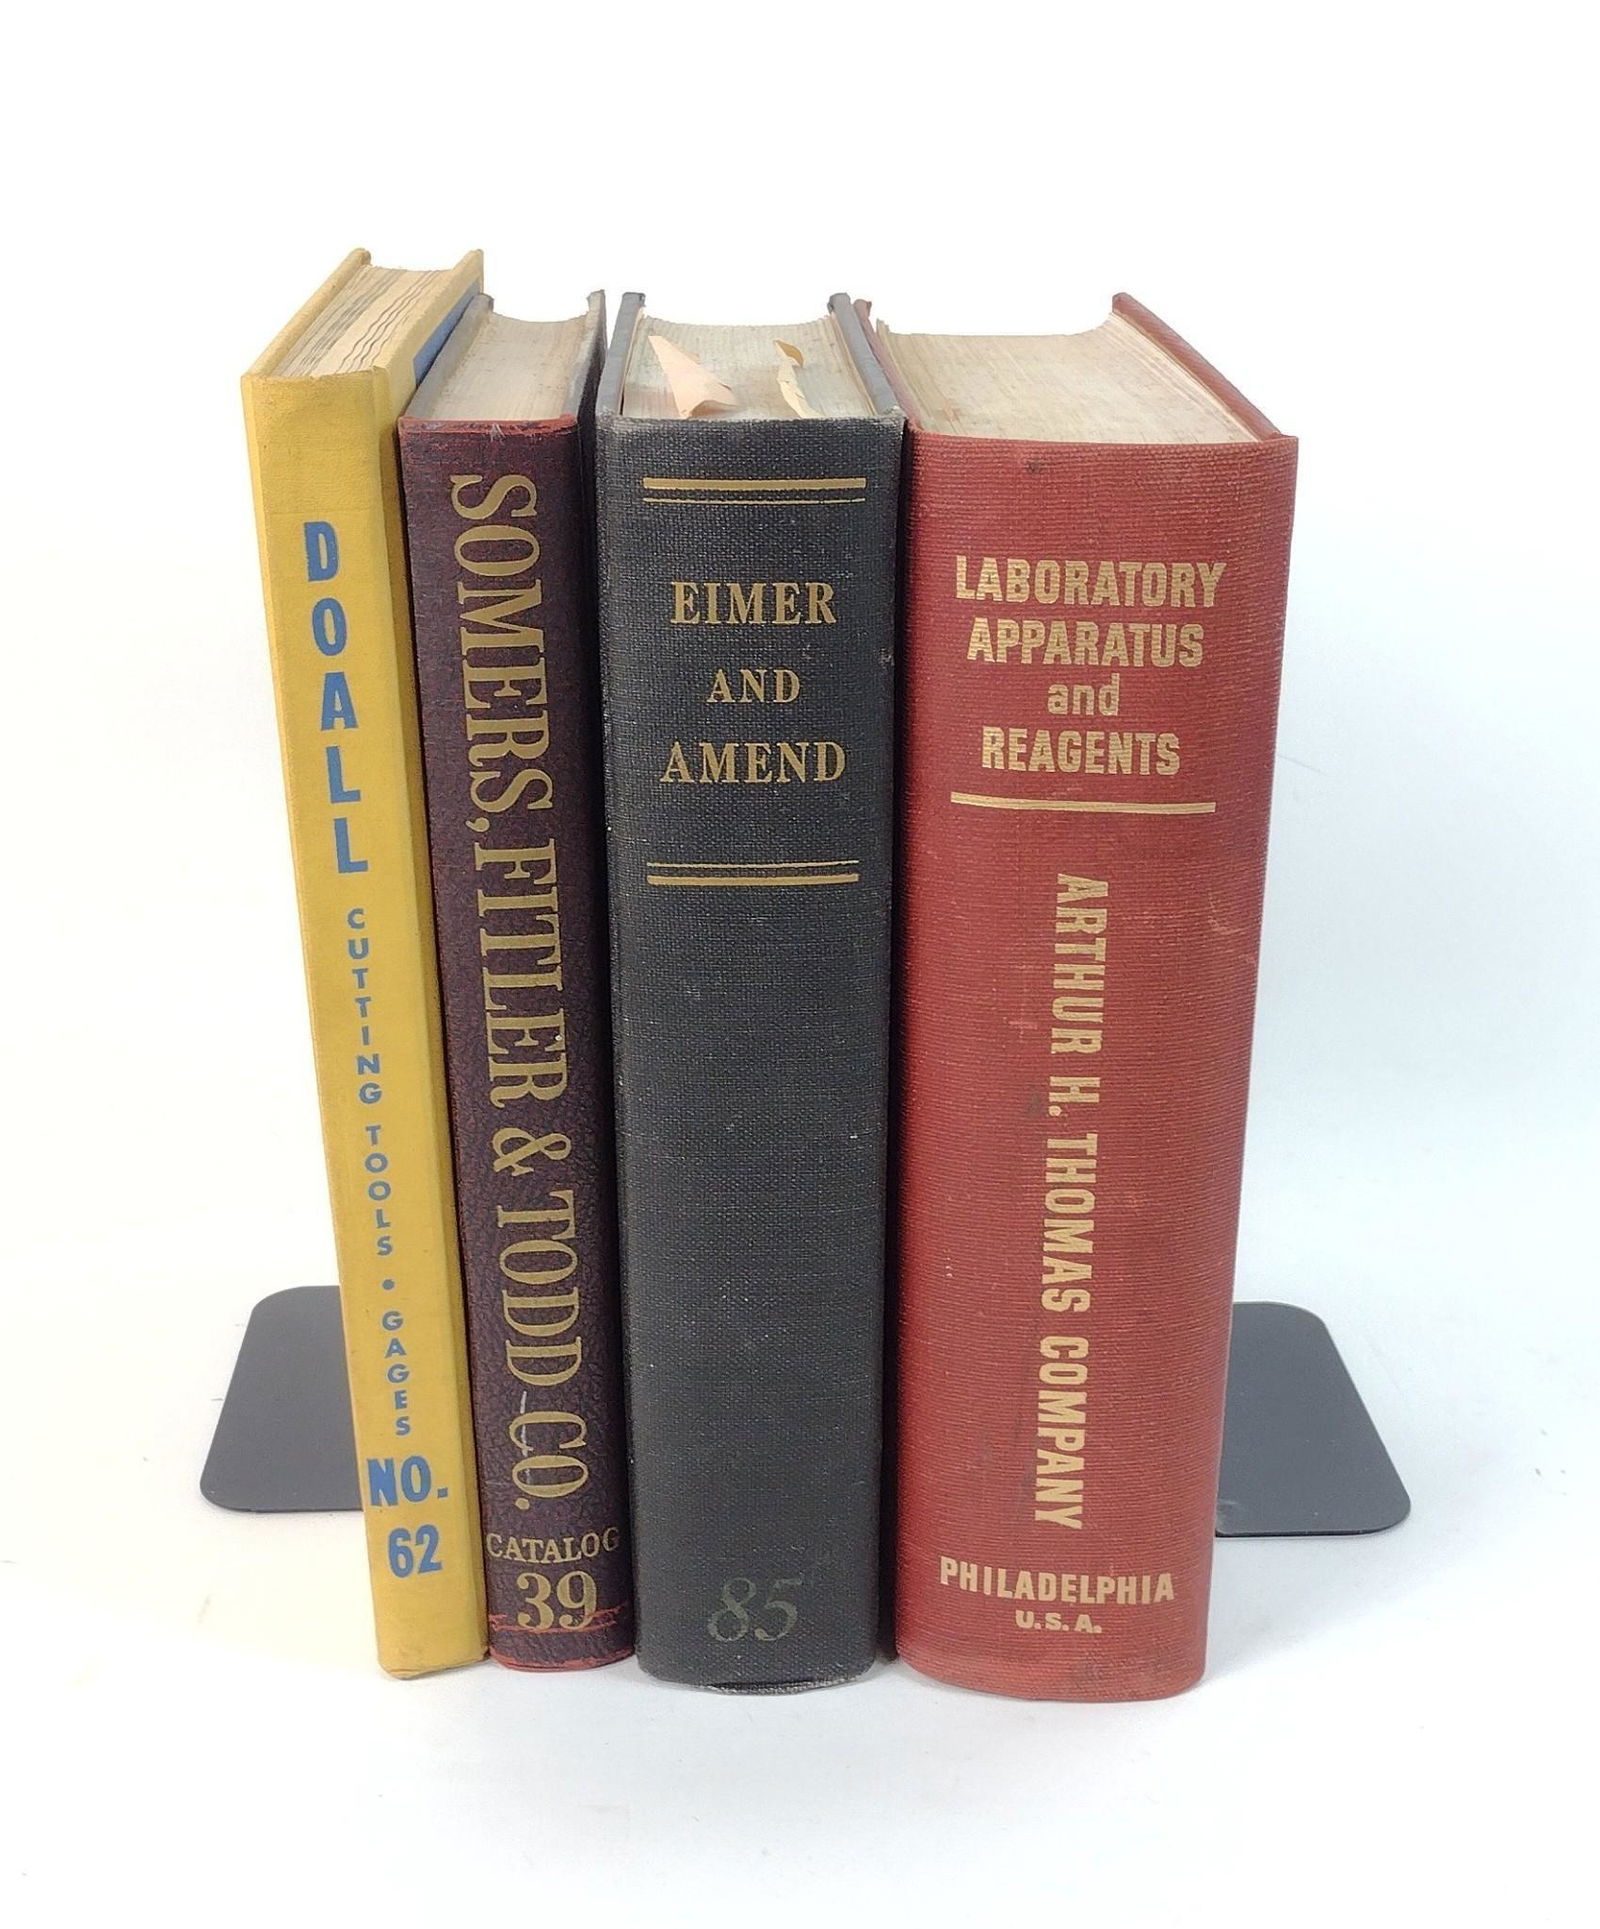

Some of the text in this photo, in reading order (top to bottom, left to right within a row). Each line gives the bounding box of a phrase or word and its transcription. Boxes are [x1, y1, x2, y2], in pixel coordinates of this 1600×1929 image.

[670, 581, 837, 625] EIMER
[955, 555, 1226, 608] LABORATORY
[966, 617, 1204, 667] APPARATUS
[303, 520, 369, 874] DOALL
[706, 668, 801, 703] AND
[1046, 674, 1119, 716] and
[660, 741, 847, 784] AMEND
[981, 726, 1181, 775] REAGENTS
[474, 837, 569, 1109] FITLER
[347, 907, 411, 1437] CUTTING TOOLS GAGES
[492, 1126, 572, 1176] &
[1035, 873, 1110, 1530] ARTHUR H. THOMAS COMPANY
[496, 1189, 583, 1386] TODD
[366, 1455, 449, 1507] NO.
[510, 1410, 589, 1509] CO.
[387, 1524, 443, 1578] 62
[486, 1527, 620, 1565] CATALOG
[516, 1570, 598, 1631] 39
[939, 1556, 1176, 1605] PHILADELPHIA
[707, 1576, 804, 1642] 85
